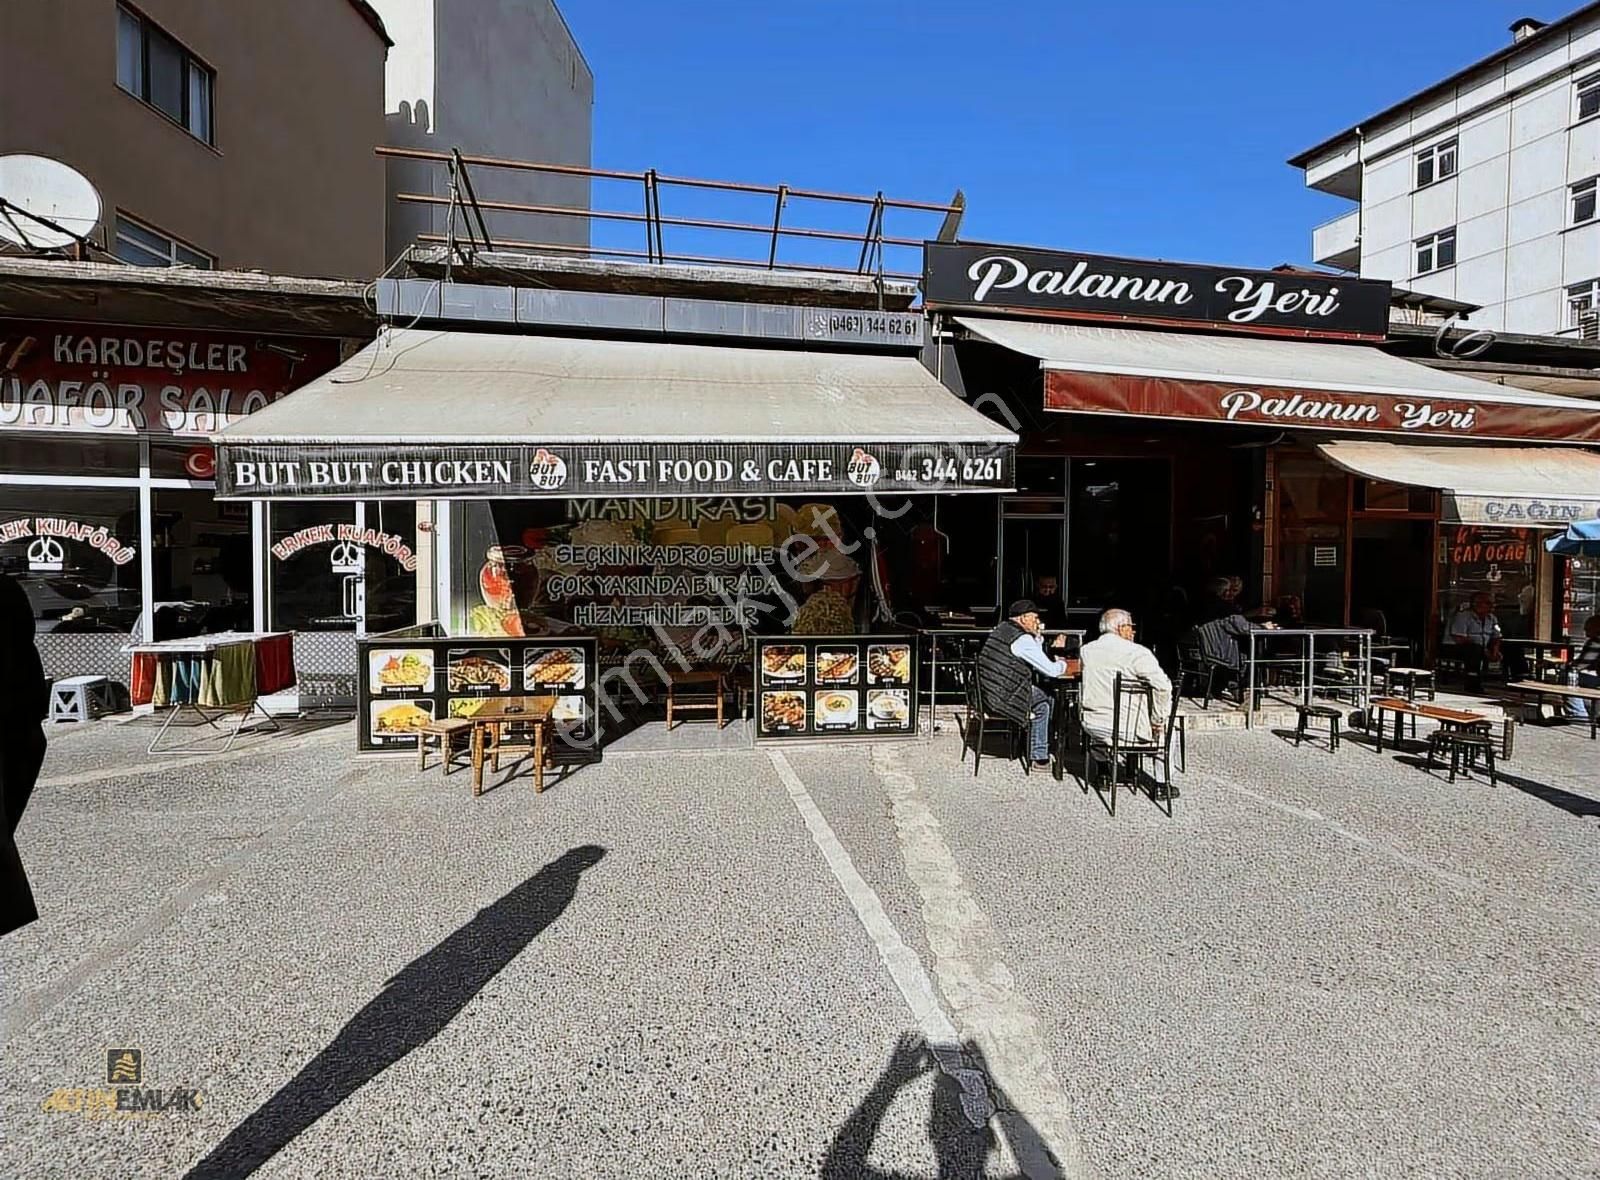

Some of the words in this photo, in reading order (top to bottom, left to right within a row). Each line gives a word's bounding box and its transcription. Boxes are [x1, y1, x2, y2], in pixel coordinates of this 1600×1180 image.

[967, 256, 1193, 306] Palanın
[1215, 276, 1341, 323] Yeri
[888, 320, 902, 335] 62
[904, 321, 917, 336] 61
[54, 334, 248, 376] KARDEŞLER
[160, 383, 285, 432] SALO
[1221, 390, 1381, 421] Palanın
[1394, 402, 1476, 430] Yeri
[235, 461, 300, 487] BUT
[309, 460, 373, 486] BUT
[381, 459, 513, 486] CHICKEN
[530, 463, 557, 475] BUT
[540, 475, 564, 486] BUT
[584, 459, 650, 484] FAST
[658, 458, 734, 484] FOOD
[740, 459, 762, 482] &
[767, 458, 833, 483] CAFE
[849, 462, 872, 474] BUT
[856, 473, 877, 485] BUT
[922, 458, 958, 482] 344
[963, 457, 1003, 481] 6261
[36, 518, 136, 565] KUAFÖRÜ
[271, 523, 334, 561] ERKEK
[638, 544, 739, 567] KADROSU
[547, 575, 594, 600] ÇOK
[594, 574, 688, 597] YAKINDA
